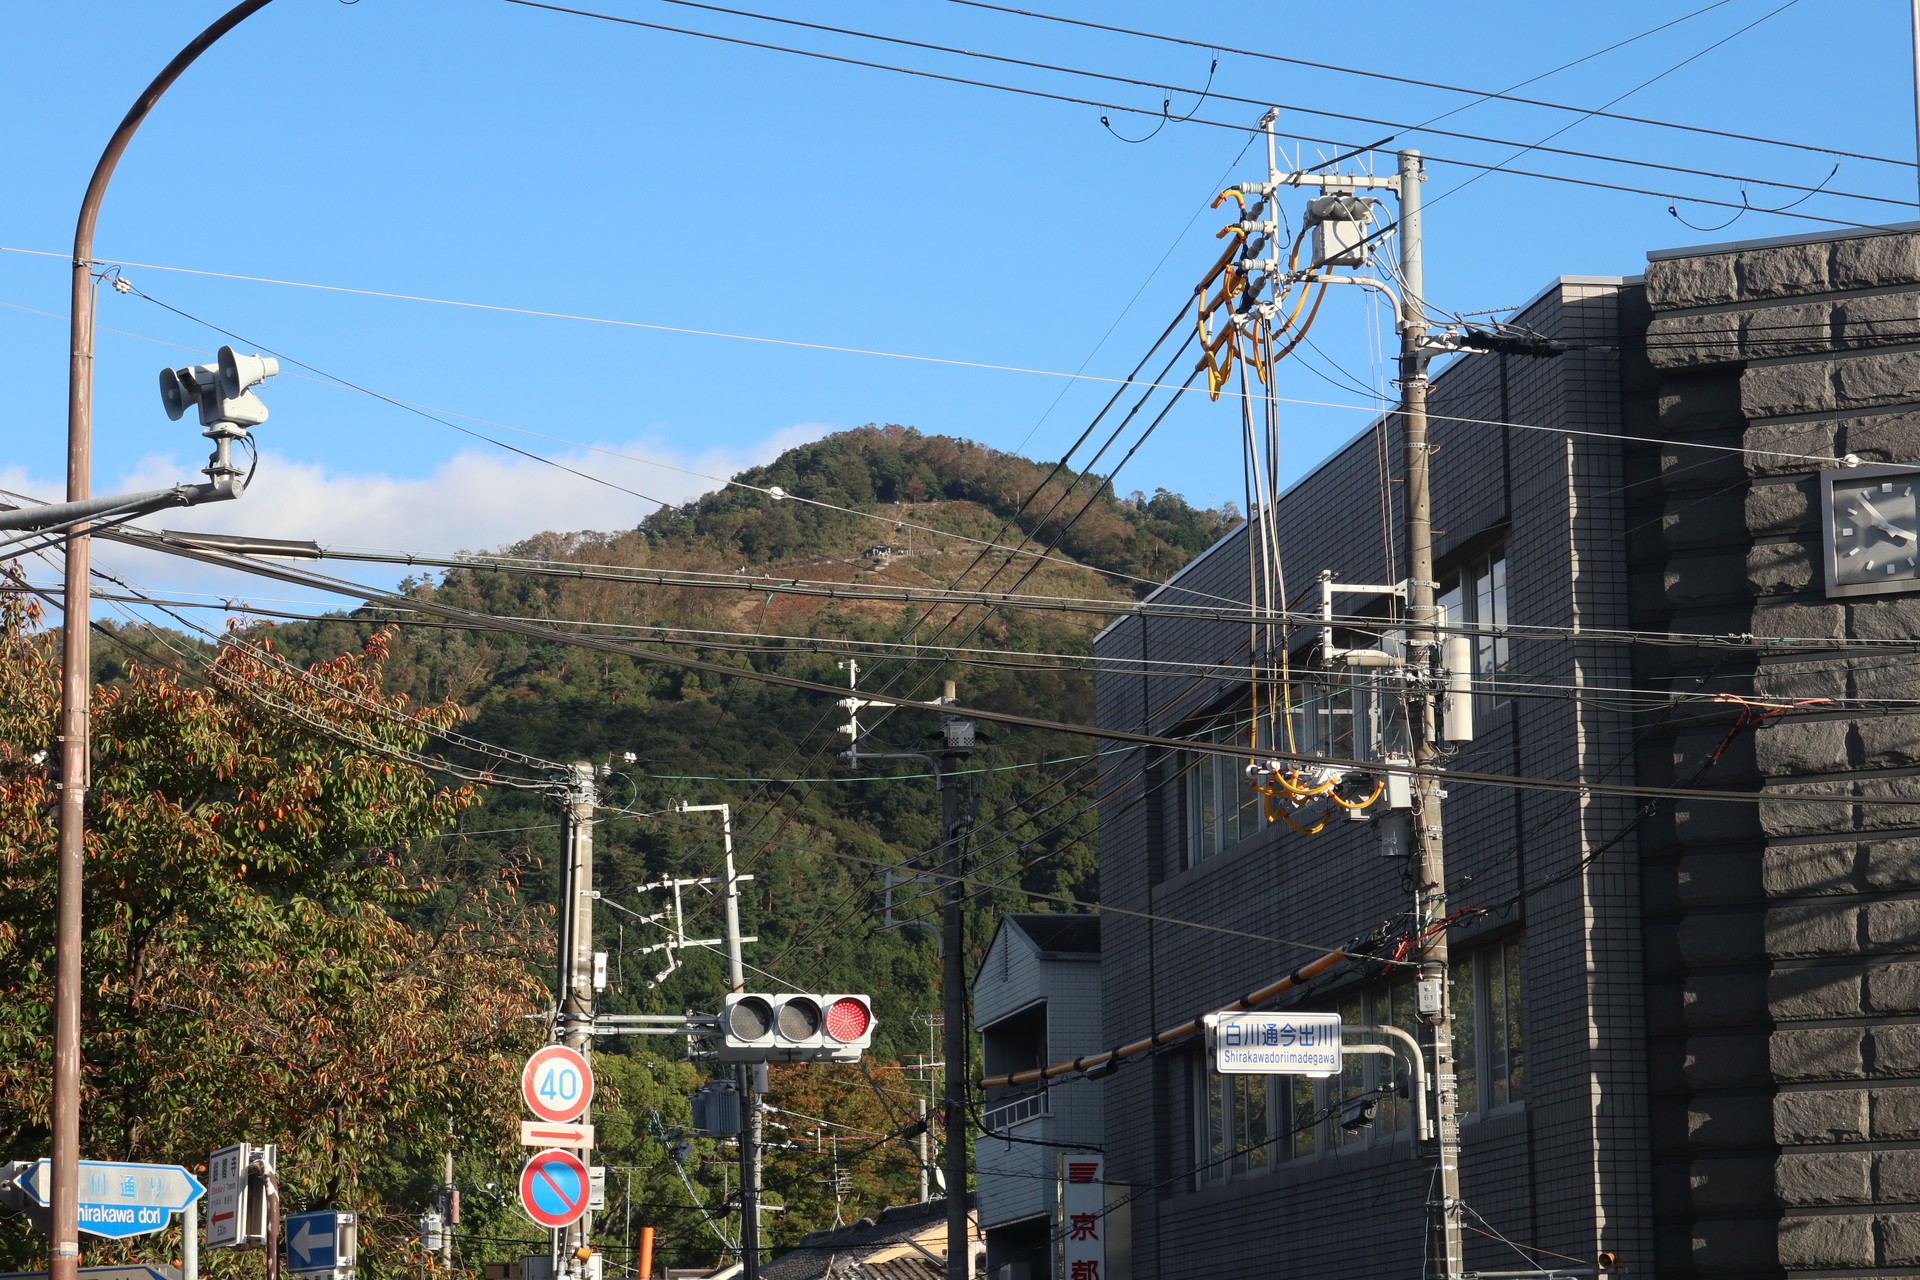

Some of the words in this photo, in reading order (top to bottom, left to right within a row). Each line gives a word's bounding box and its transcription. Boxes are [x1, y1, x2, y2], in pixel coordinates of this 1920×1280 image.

[1225, 1022, 1333, 1047] 白川通今出川
[1224, 1050, 1335, 1066] Shirakawadoriimadegawa
[540, 1068, 577, 1101] 40
[91, 1173, 163, 1199] 川通り
[78, 1205, 134, 1223] hirakawa
[138, 1207, 161, 1224] dori
